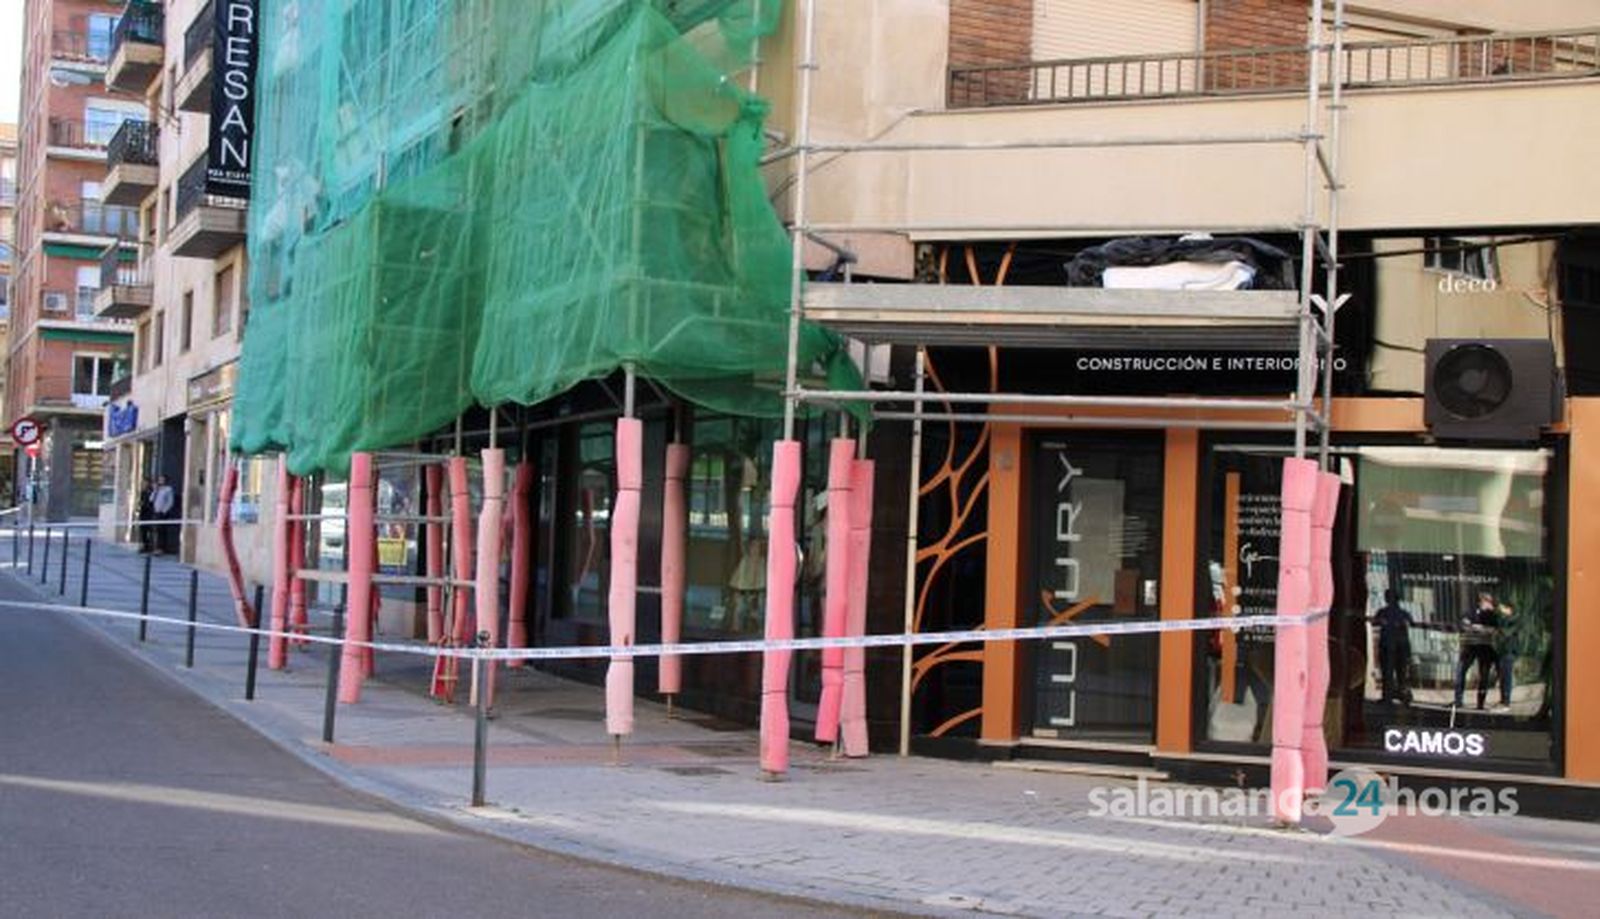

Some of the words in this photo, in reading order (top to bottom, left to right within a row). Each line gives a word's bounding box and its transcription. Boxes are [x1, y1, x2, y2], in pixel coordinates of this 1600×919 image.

[221, 3, 253, 168] RESAN
[1438, 273, 1497, 293] deco
[1076, 355, 1208, 371] CONSTRUCCIÓN
[1212, 357, 1223, 371] E
[1227, 357, 1348, 371] INTERIORO
[1042, 452, 1110, 727] LUXURY
[1384, 729, 1486, 757] CAMOS
